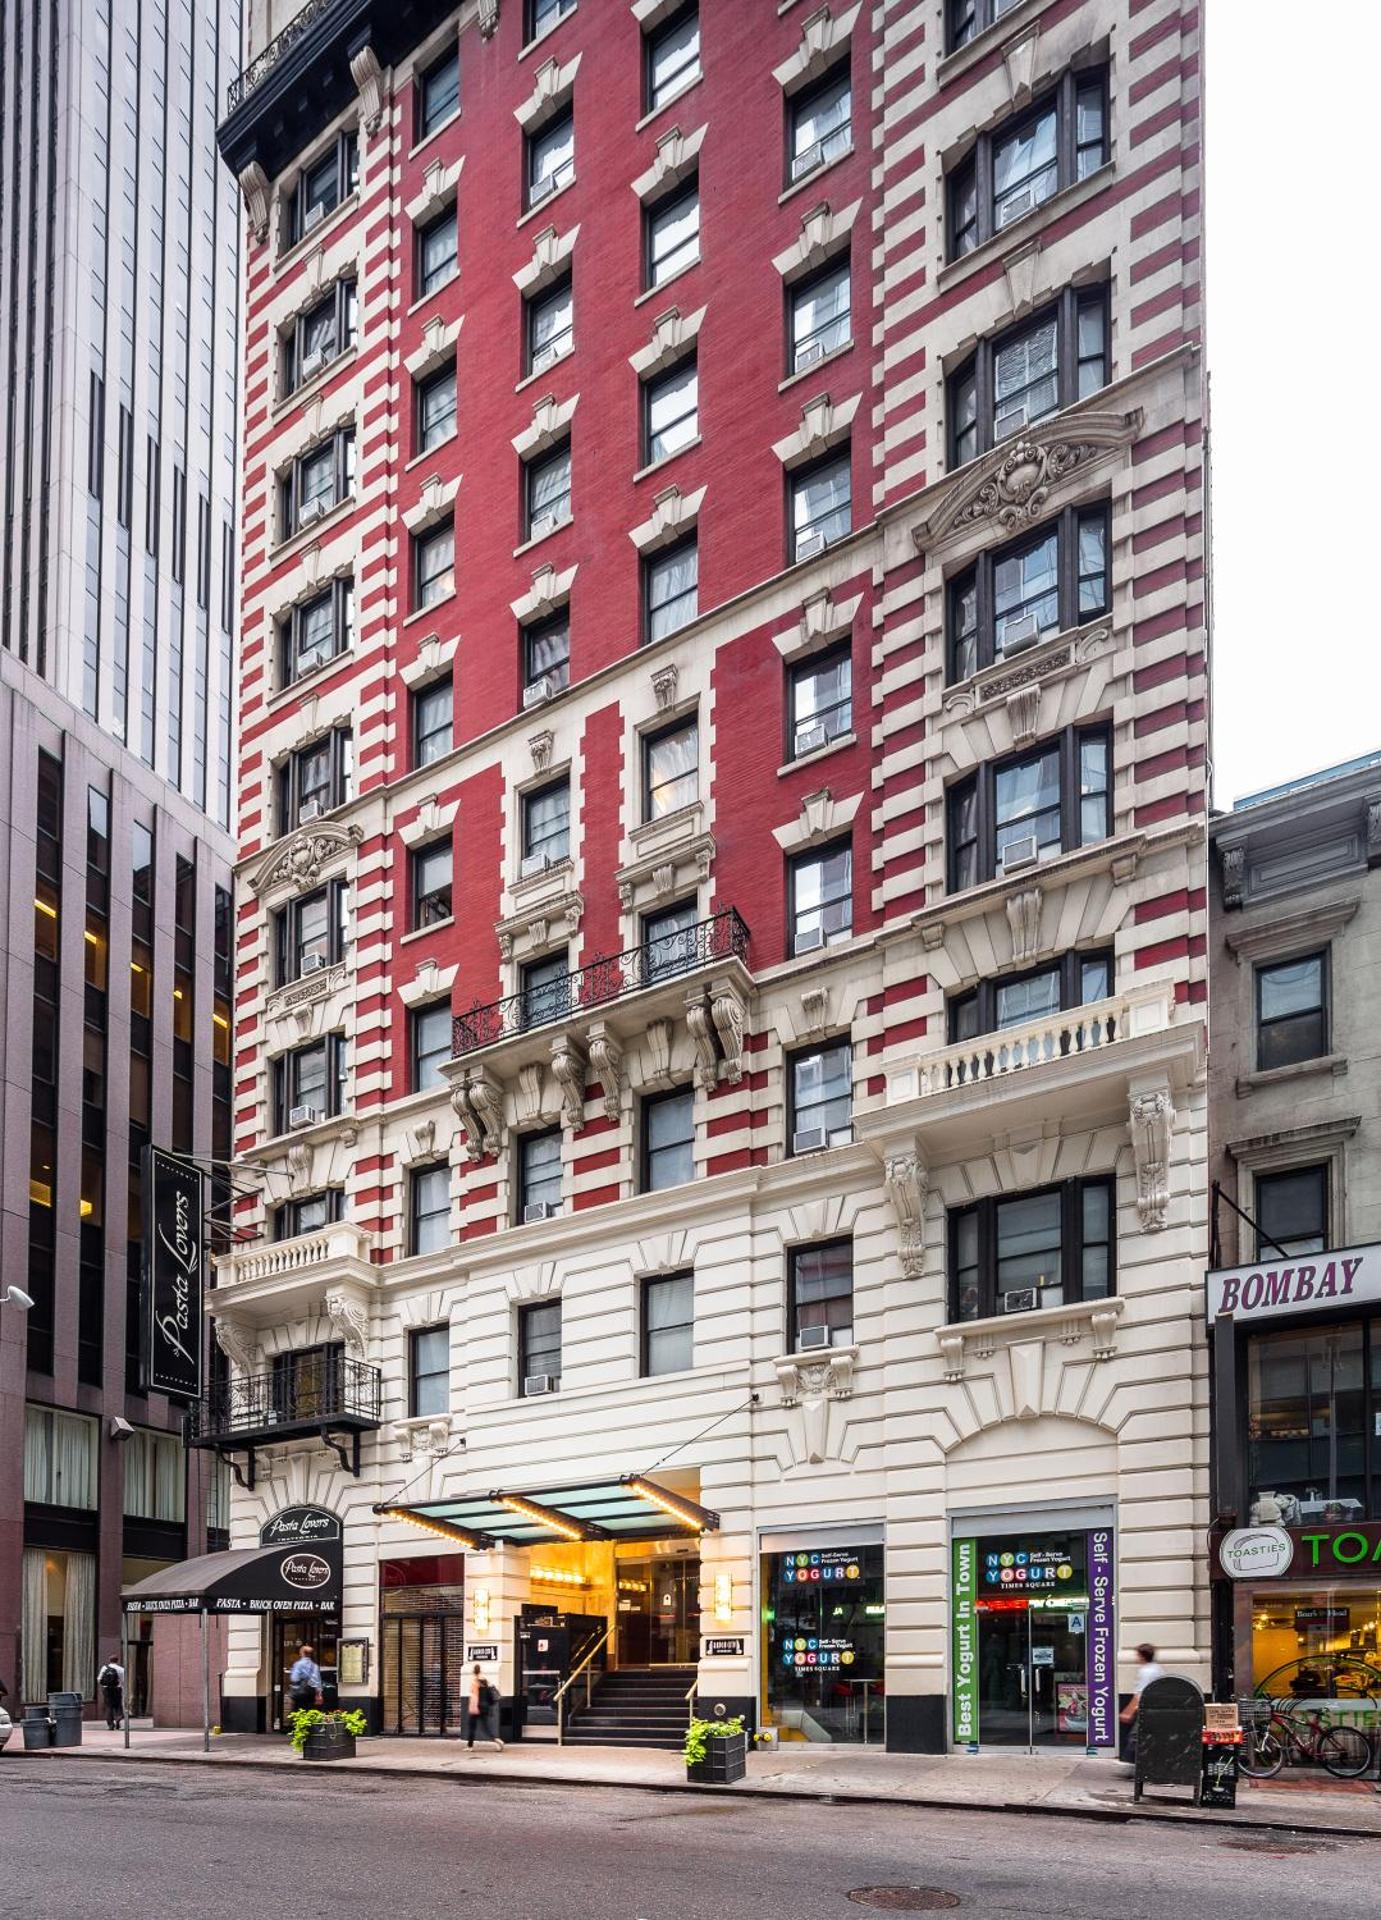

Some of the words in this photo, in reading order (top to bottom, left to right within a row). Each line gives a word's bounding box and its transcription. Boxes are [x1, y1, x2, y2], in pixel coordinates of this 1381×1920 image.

[158, 1190, 198, 1274] Lovers
[1218, 1257, 1364, 1313] BOMBAY
[156, 1273, 194, 1365] Pasta
[270, 1515, 299, 1536] Pasta
[299, 1513, 330, 1535] Lovers
[1094, 1532, 1108, 1563] Self
[1227, 1543, 1286, 1559] TOASTIES
[1301, 1532, 1381, 1566] TO
[285, 1559, 307, 1575] Pasta
[308, 1561, 329, 1578] Lovers
[784, 1552, 820, 1568] NYC
[956, 1544, 970, 1596] Town
[986, 1552, 1028, 1567] NYC
[784, 1564, 860, 1582] YOGURT
[986, 1564, 1072, 1583] YOGURT
[216, 1599, 242, 1608] PASTA
[250, 1600, 272, 1609] BRICK
[273, 1600, 293, 1610] OVEN
[293, 1601, 314, 1610] PIZZA
[320, 1601, 335, 1610] BAR
[956, 1600, 970, 1619] In
[1094, 1577, 1109, 1623] Serve
[1071, 1616, 1082, 1627] A
[783, 1638, 818, 1651] NYC
[956, 1624, 974, 1688] Yogurt
[1095, 1628, 1109, 1682] Frozen
[783, 1651, 854, 1665] YOGURT
[958, 1693, 972, 1736] Best
[1092, 1687, 1109, 1741] Yogurt
